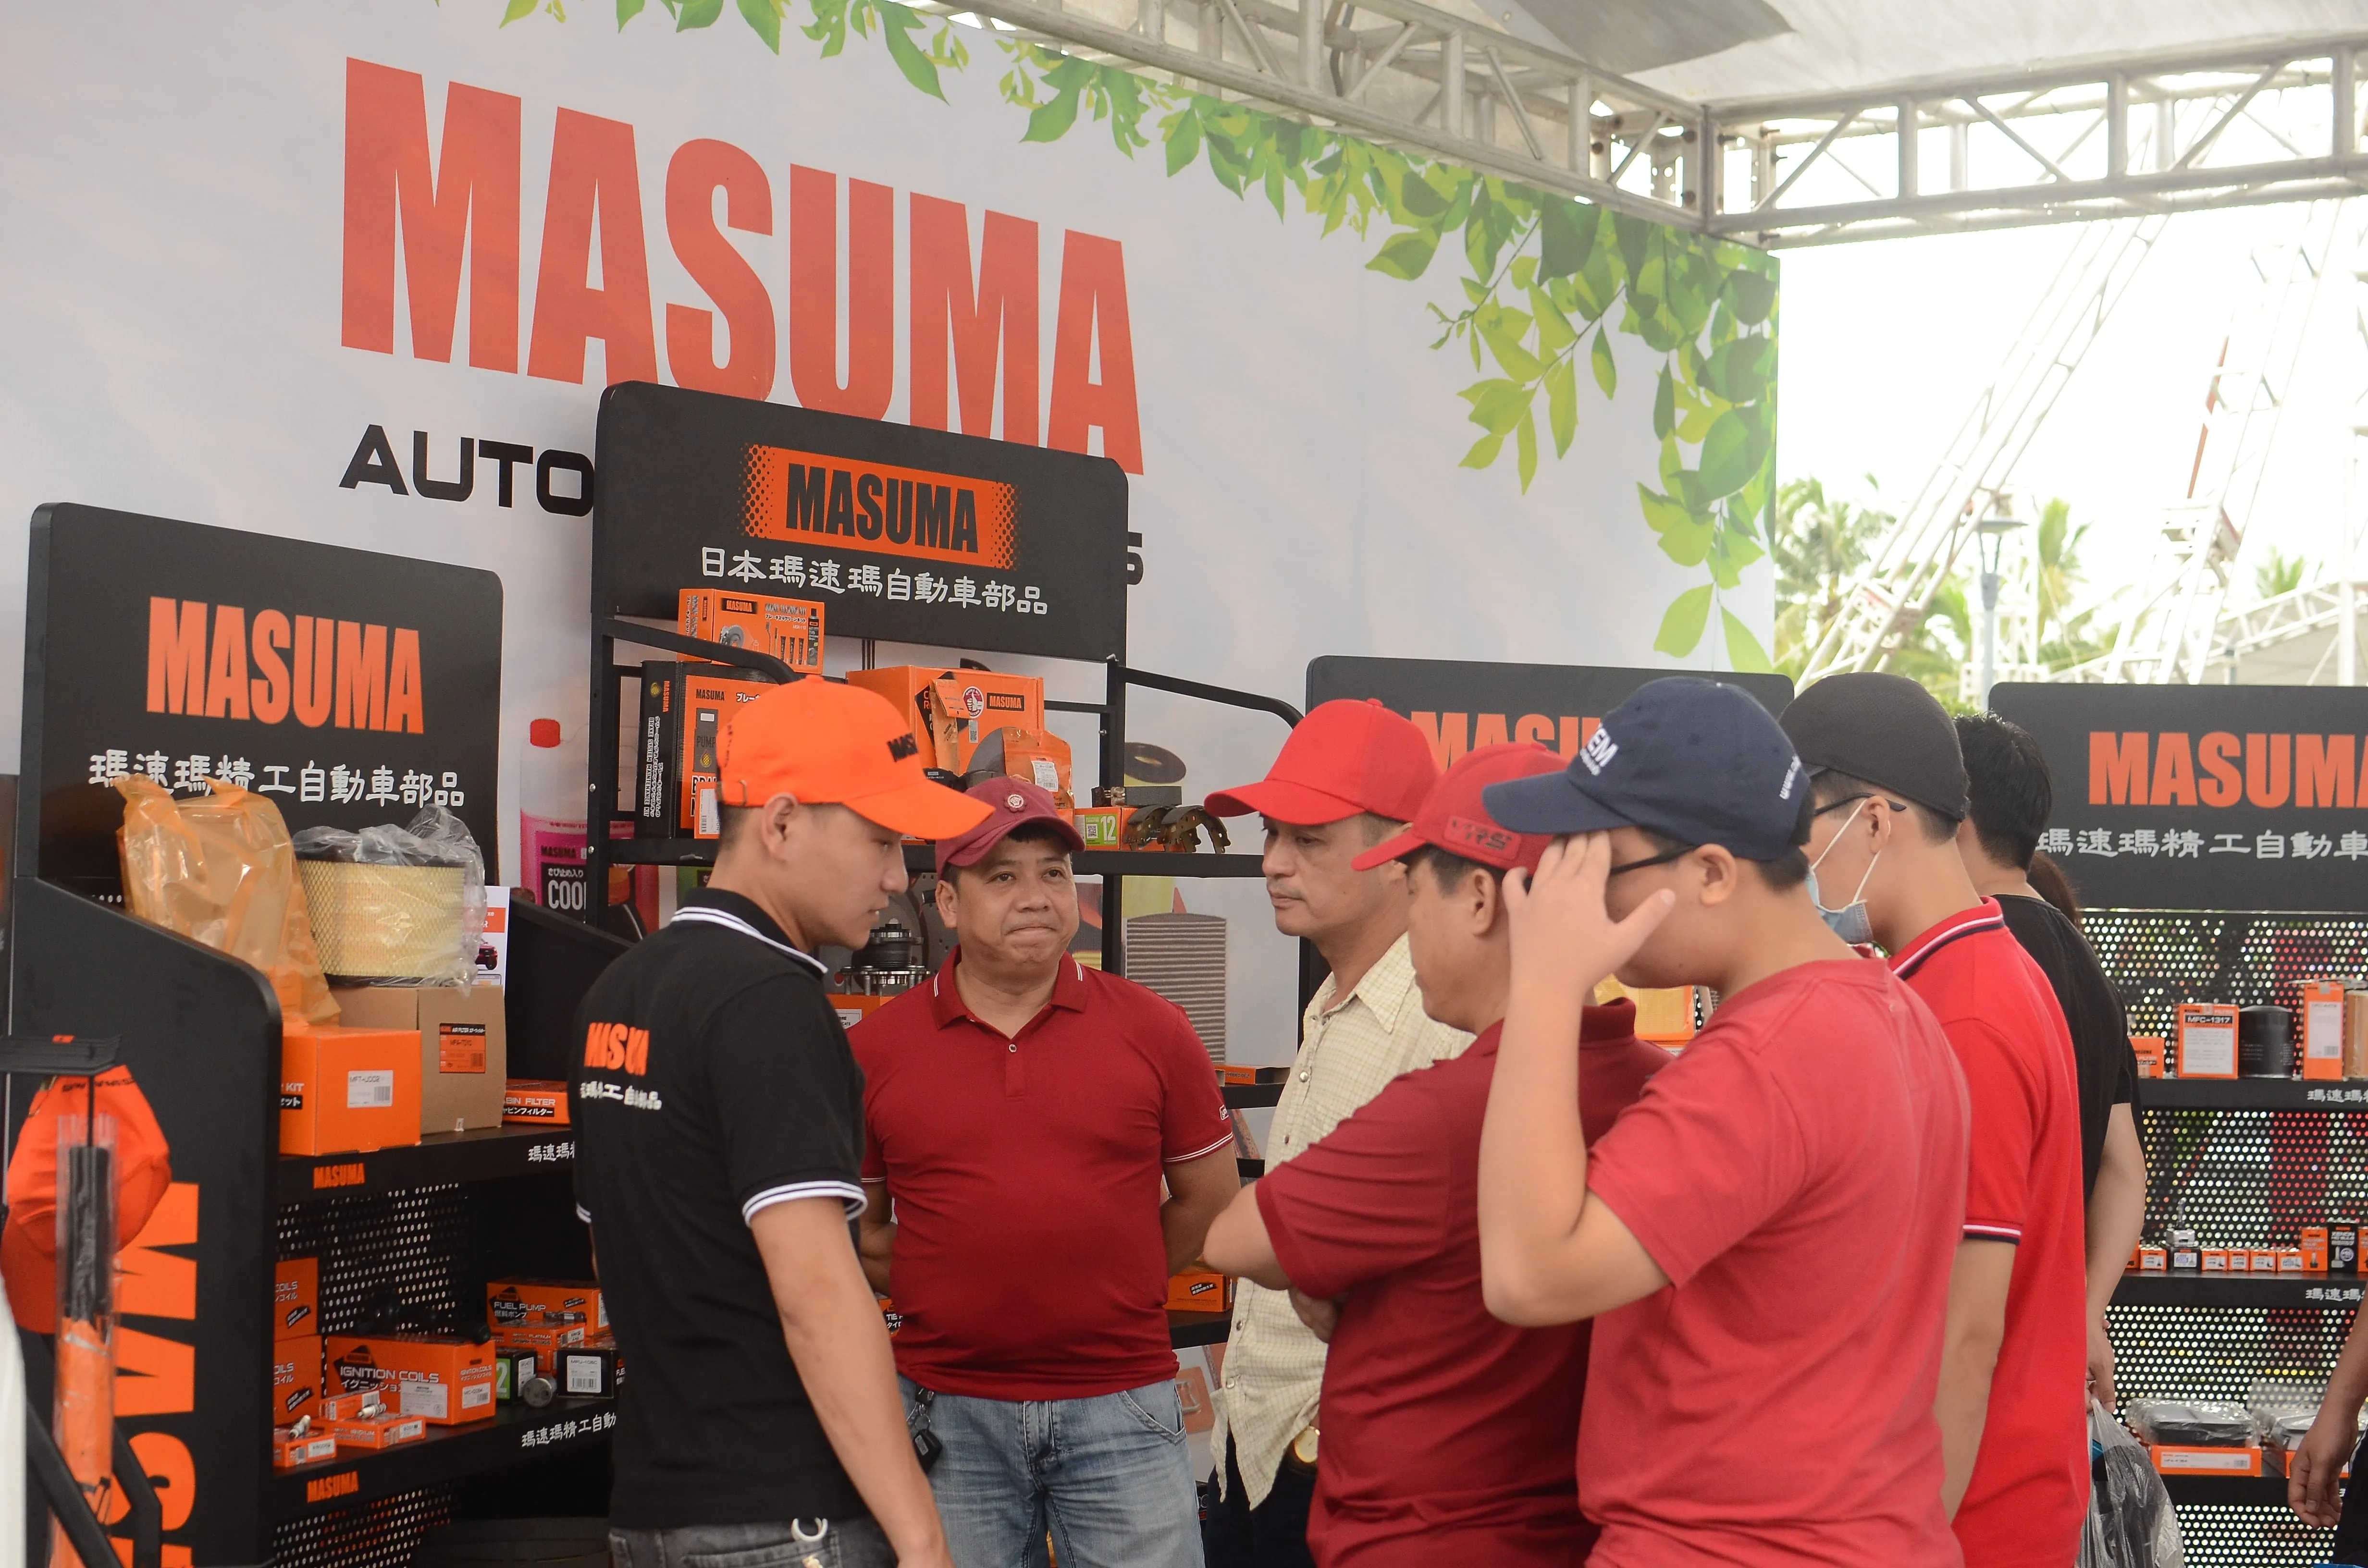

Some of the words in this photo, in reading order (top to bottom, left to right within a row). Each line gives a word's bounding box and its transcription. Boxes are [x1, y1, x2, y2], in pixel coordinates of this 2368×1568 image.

[341, 56, 1144, 475] MASUMA
[338, 424, 594, 516] AUTO
[786, 463, 978, 553] MASUMA
[701, 546, 1048, 615] 日本瑪速瑪自動車部品
[726, 600, 753, 612] MASUMA
[147, 596, 424, 734] MASUMA
[662, 680, 670, 712] MASUMA
[696, 688, 725, 701] MASUMA
[989, 696, 1022, 709] MASUMA
[696, 735, 716, 747] PUMP
[2089, 731, 2368, 808] MASUM
[1100, 816, 1116, 841] 12
[548, 880, 586, 910] COO
[2187, 1015, 2230, 1024] MFC-1317
[286, 1083, 305, 1092] KIT
[2307, 1089, 2368, 1103] 瑪速瑪
[525, 1098, 555, 1106] FILTER
[313, 1163, 366, 1189] MASUMA
[2305, 1287, 2366, 1301] 瑪速瑪
[494, 1301, 518, 1310] FUEL
[340, 1366, 396, 1380] IGNITION
[399, 1370, 439, 1383] COILS
[341, 1378, 402, 1393] イグニッショ
[521, 1411, 617, 1448] 瑪速瑪精工自動
[308, 1470, 359, 1503] MASUMA
